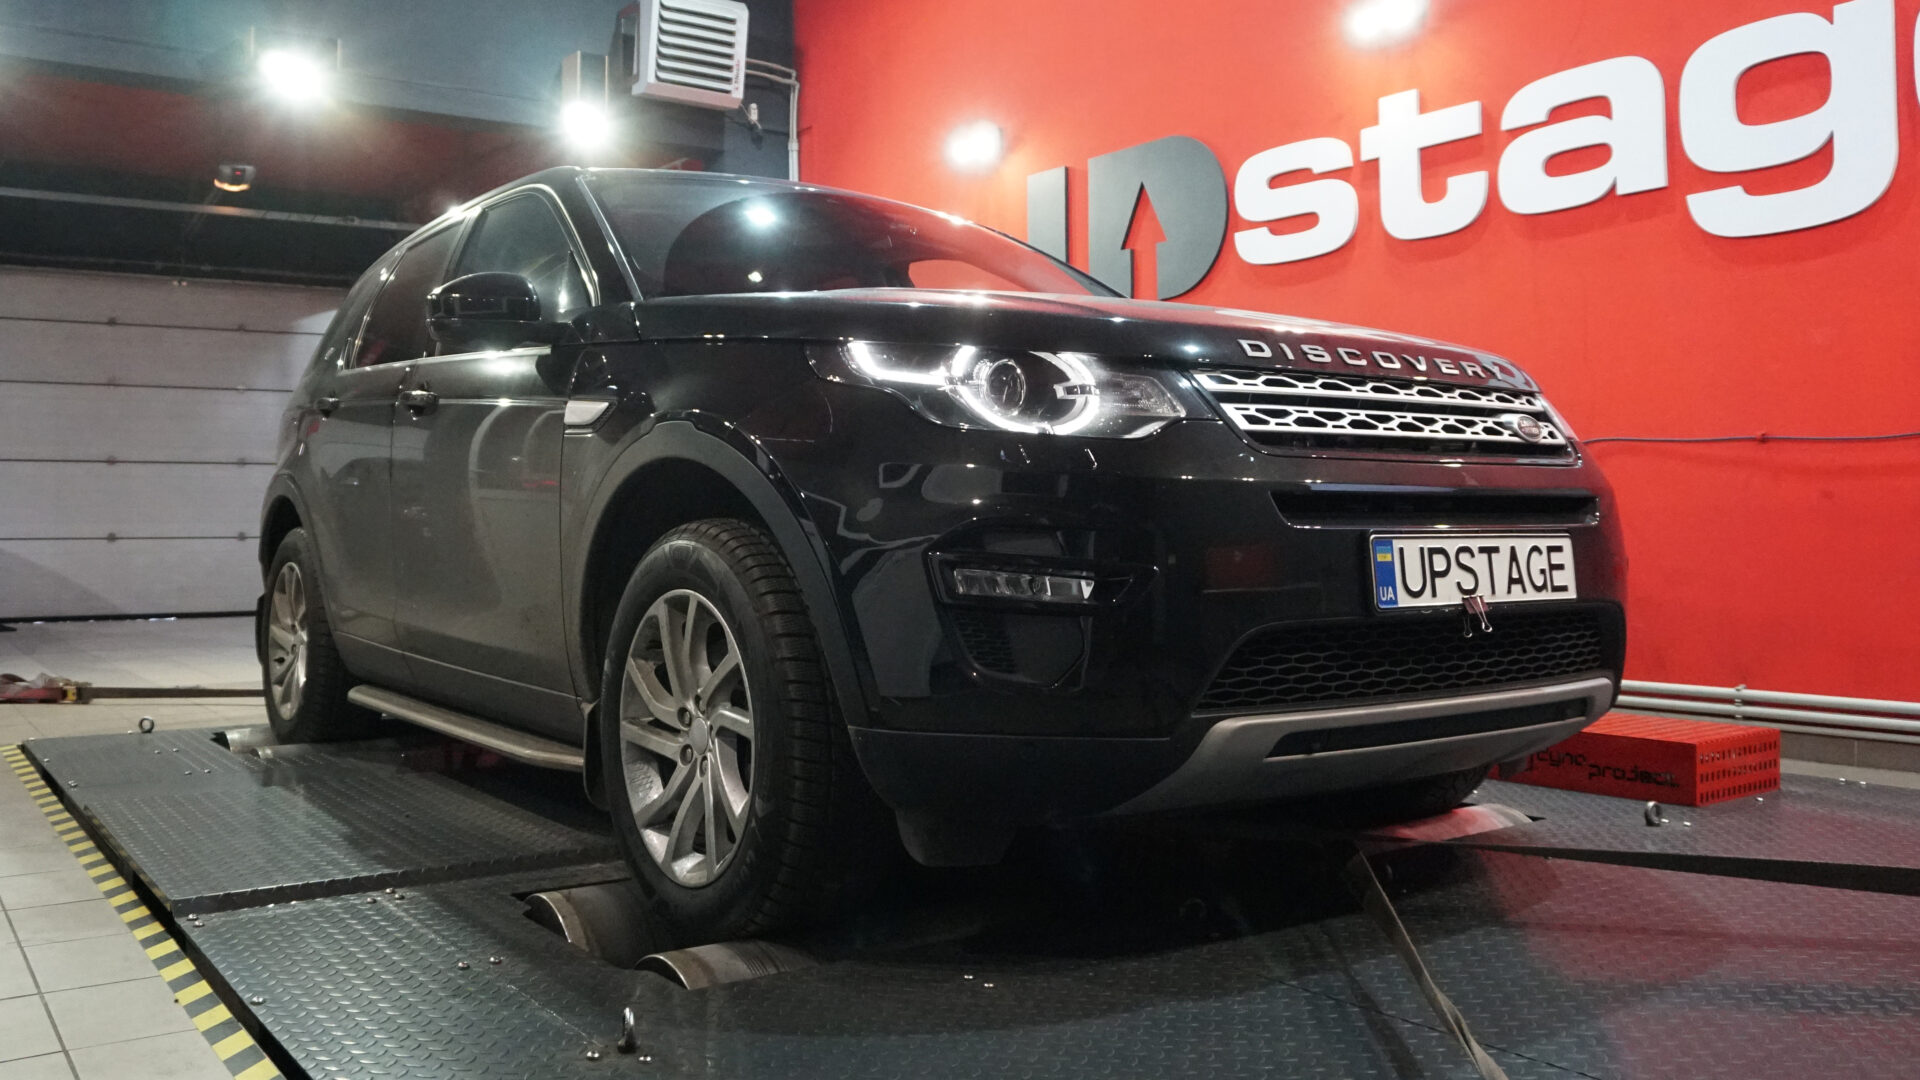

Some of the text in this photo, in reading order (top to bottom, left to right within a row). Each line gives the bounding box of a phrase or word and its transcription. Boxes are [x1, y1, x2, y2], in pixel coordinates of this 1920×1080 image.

[1238, 339, 1504, 381] DISCOVERY
[1399, 545, 1569, 598] UPSTAGE
[1380, 586, 1395, 601] UA
